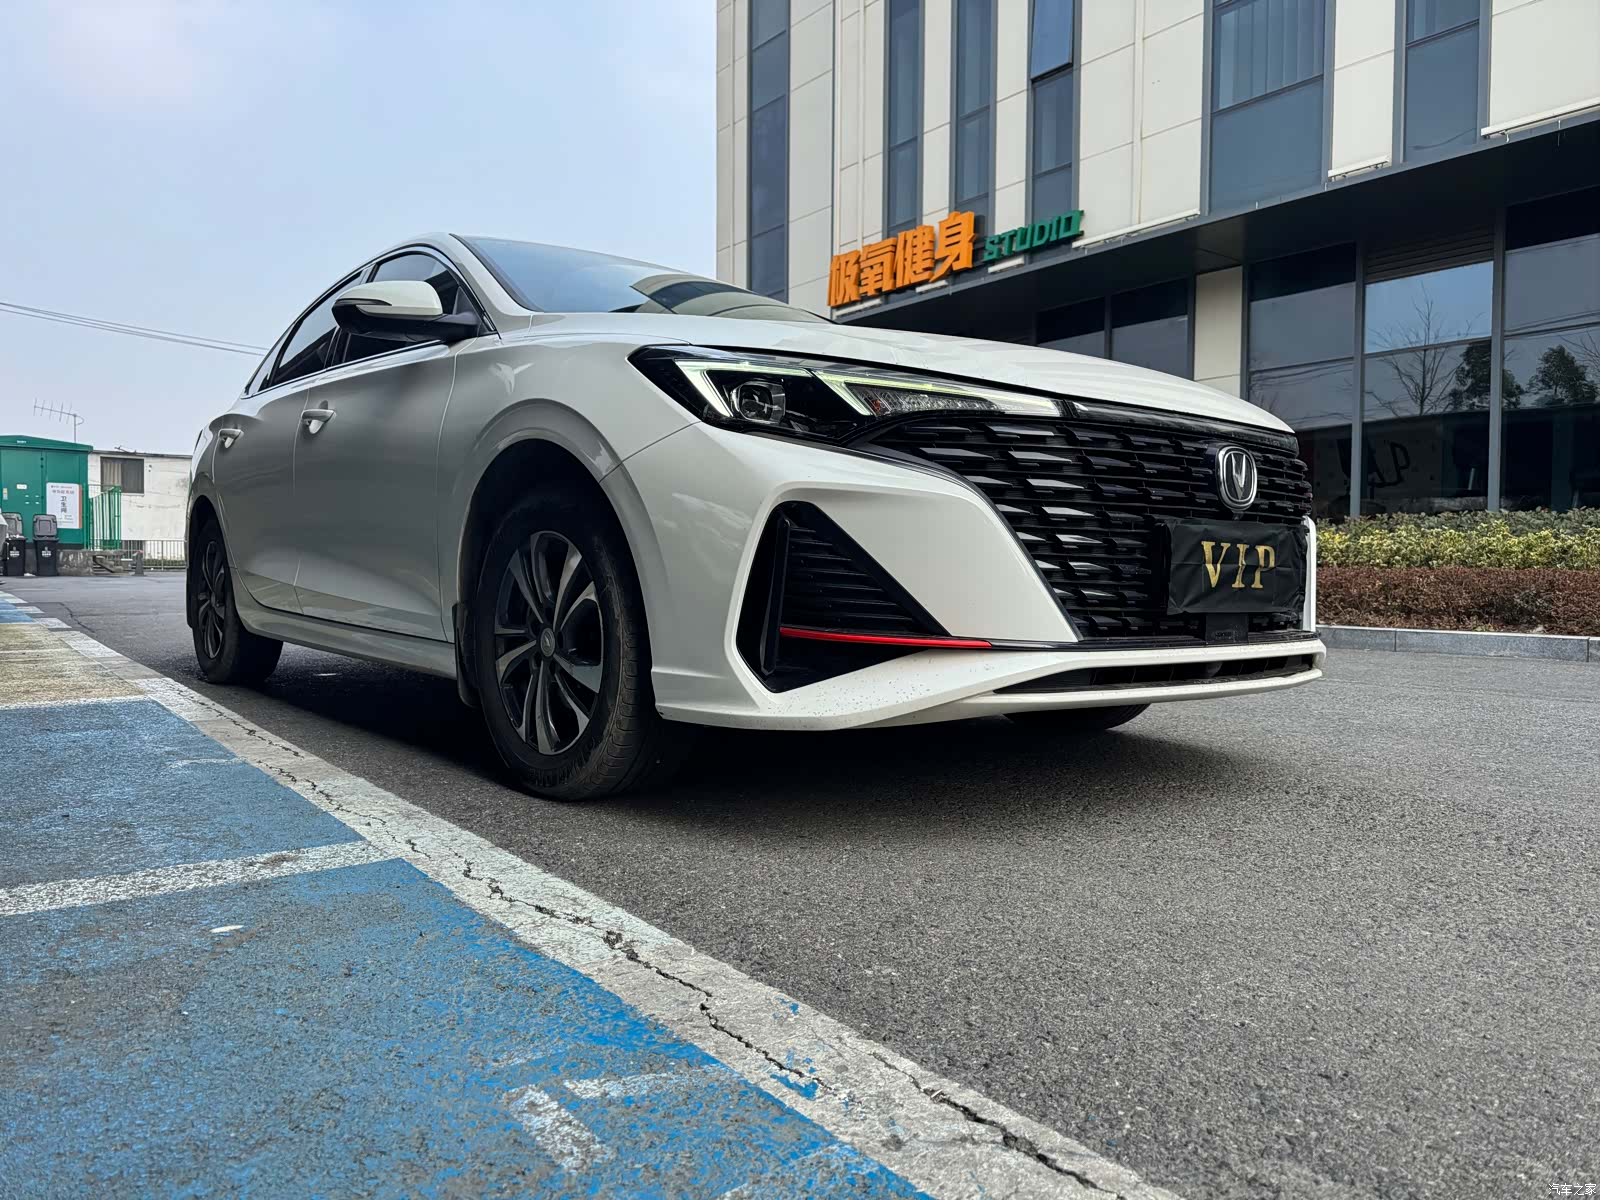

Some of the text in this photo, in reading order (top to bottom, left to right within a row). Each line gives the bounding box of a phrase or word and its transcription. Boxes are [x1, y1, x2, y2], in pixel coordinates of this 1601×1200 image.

[827, 211, 975, 306] 极氧健身
[984, 210, 1084, 262] STUDIO
[1201, 541, 1275, 588] VIP
